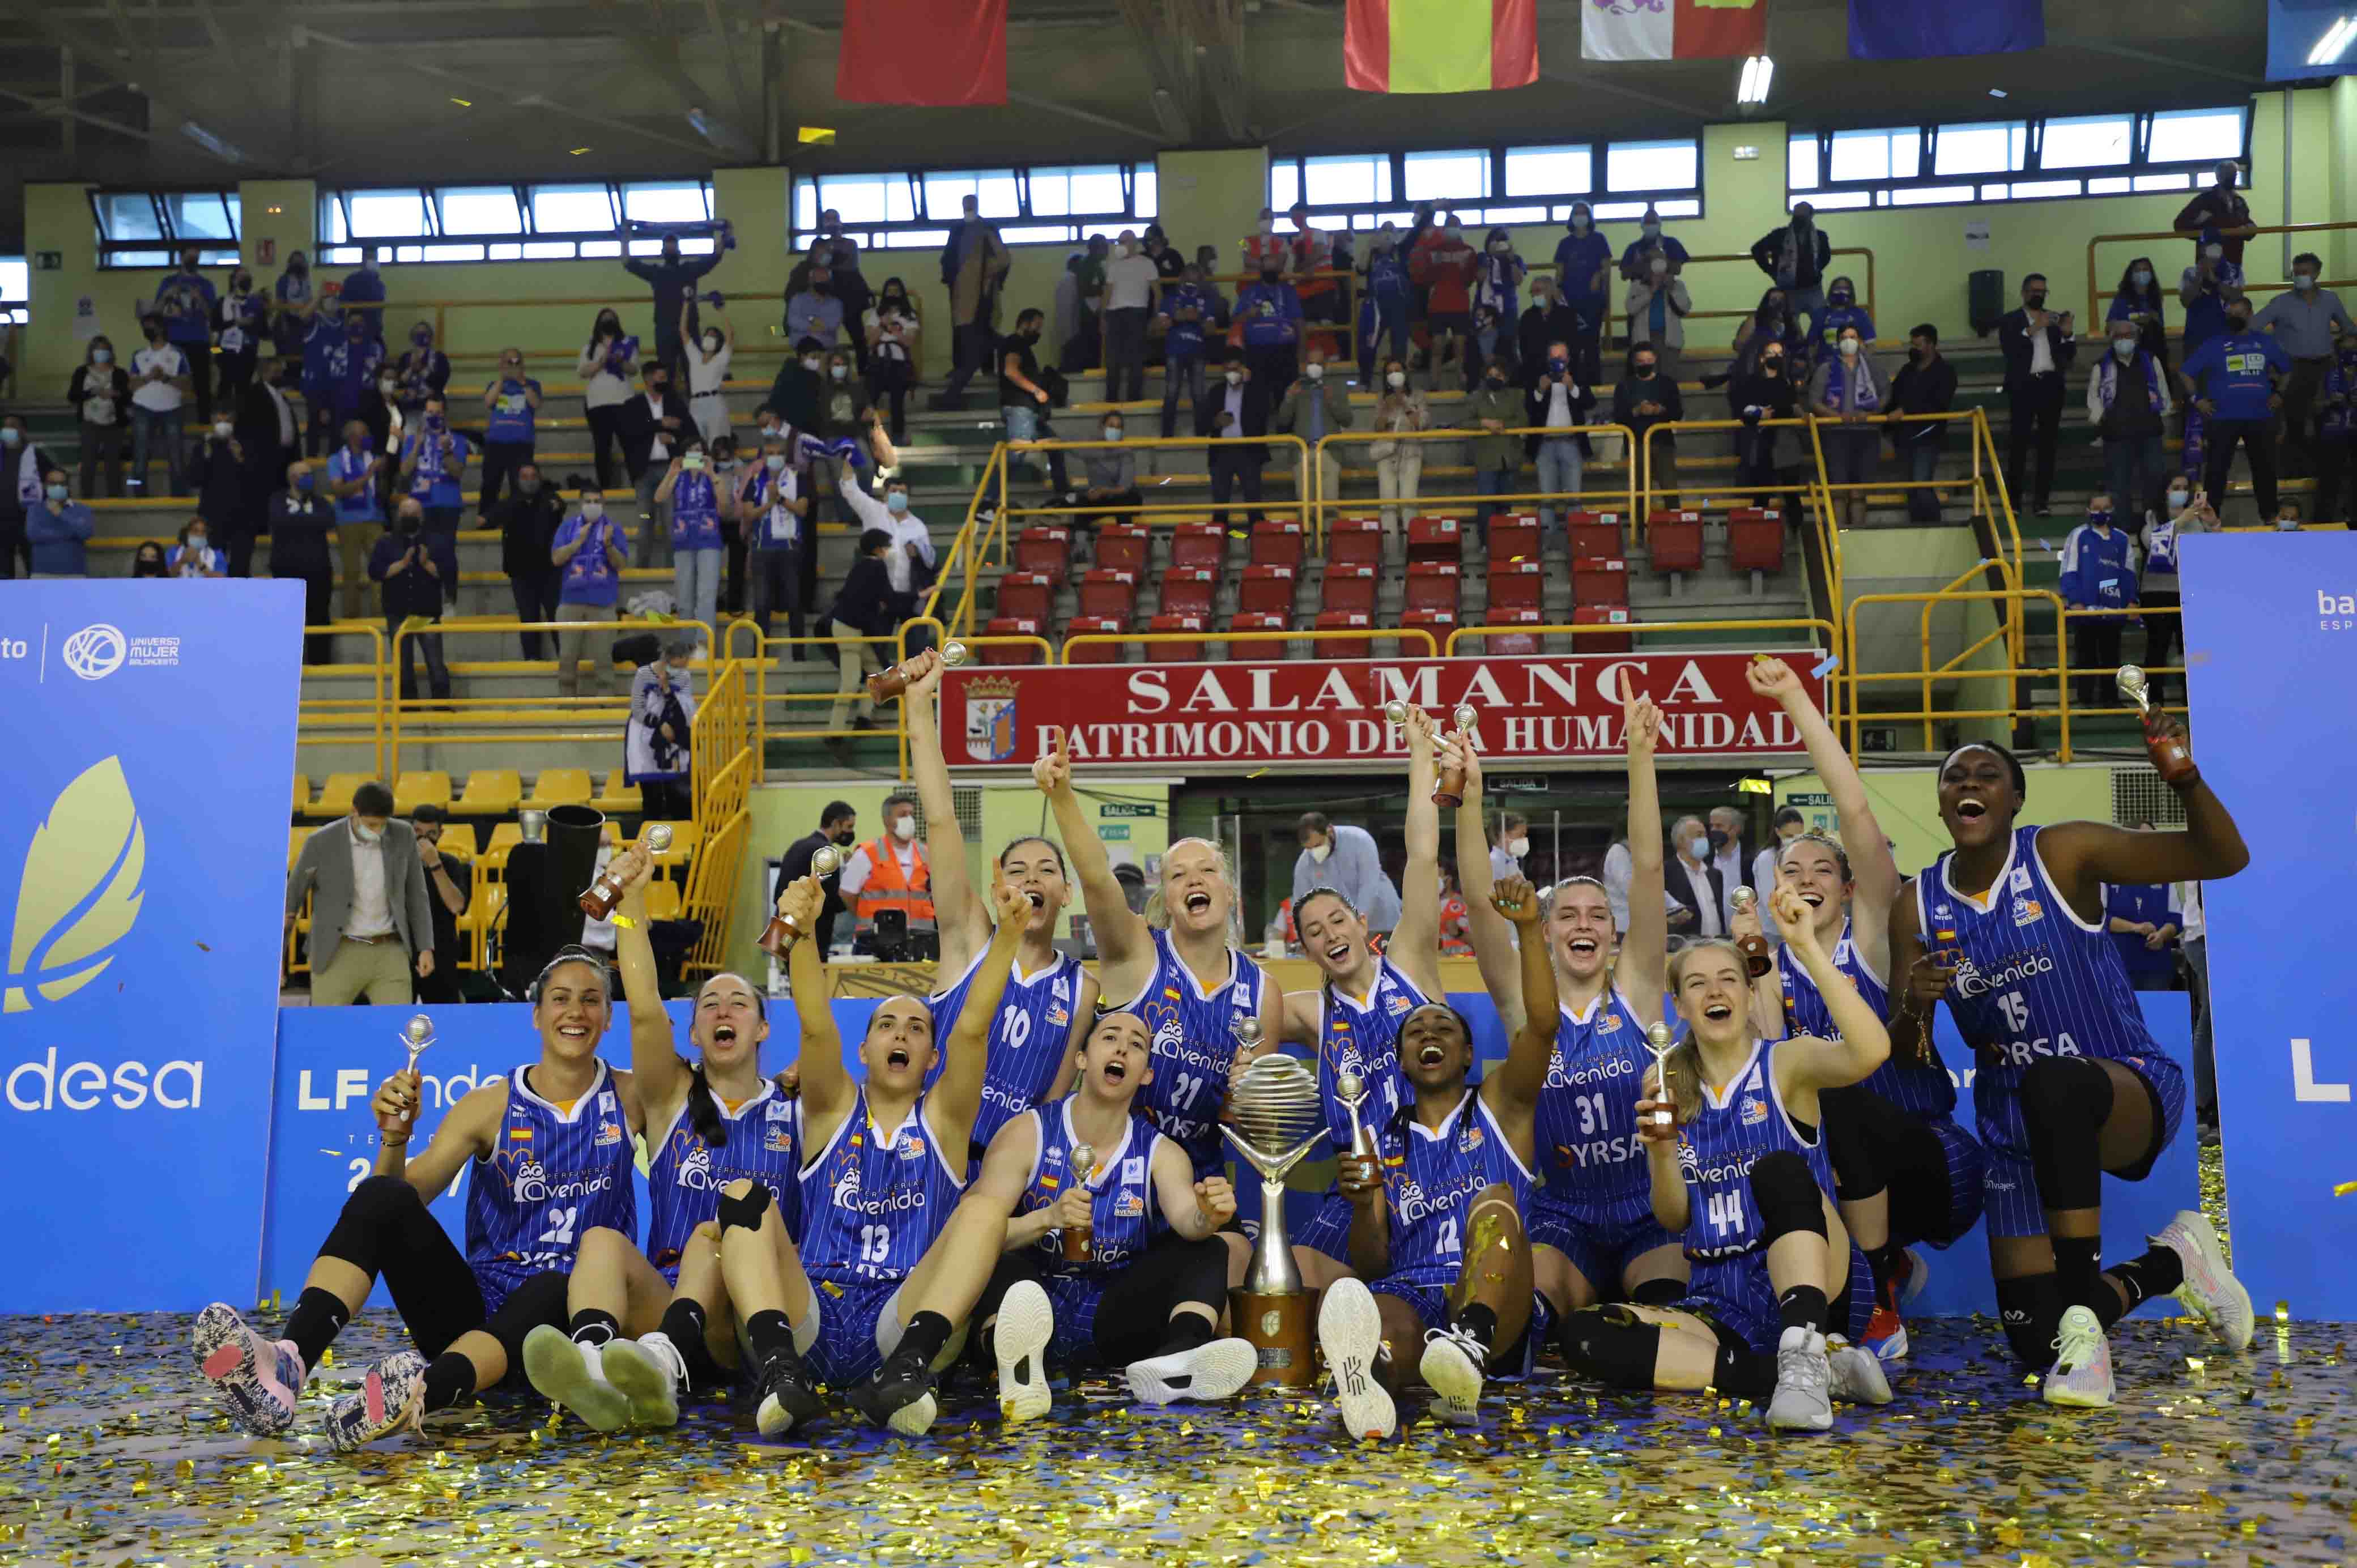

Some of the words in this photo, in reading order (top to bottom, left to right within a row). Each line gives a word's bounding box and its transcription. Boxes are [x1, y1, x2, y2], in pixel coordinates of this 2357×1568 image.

[2318, 589, 2357, 615] ba
[2321, 620, 2352, 630] ESP
[1, 637, 27, 658] to
[130, 647, 178, 657] MUJER
[1128, 660, 1722, 713] SALAMANCA
[1035, 720, 1330, 759] PATRIMONIO
[1002, 1004, 1030, 1048] 10
[1997, 991, 2029, 1033] 15
[0, 1046, 203, 1111] desa
[298, 1068, 368, 1110] LF
[2291, 1038, 2351, 1101] L
[1171, 1072, 1203, 1110] 21
[1575, 1093, 1609, 1135] 31
[1044, 1157, 1062, 1166] errea
[1709, 1189, 1745, 1236] 44
[861, 1224, 890, 1263] 13
